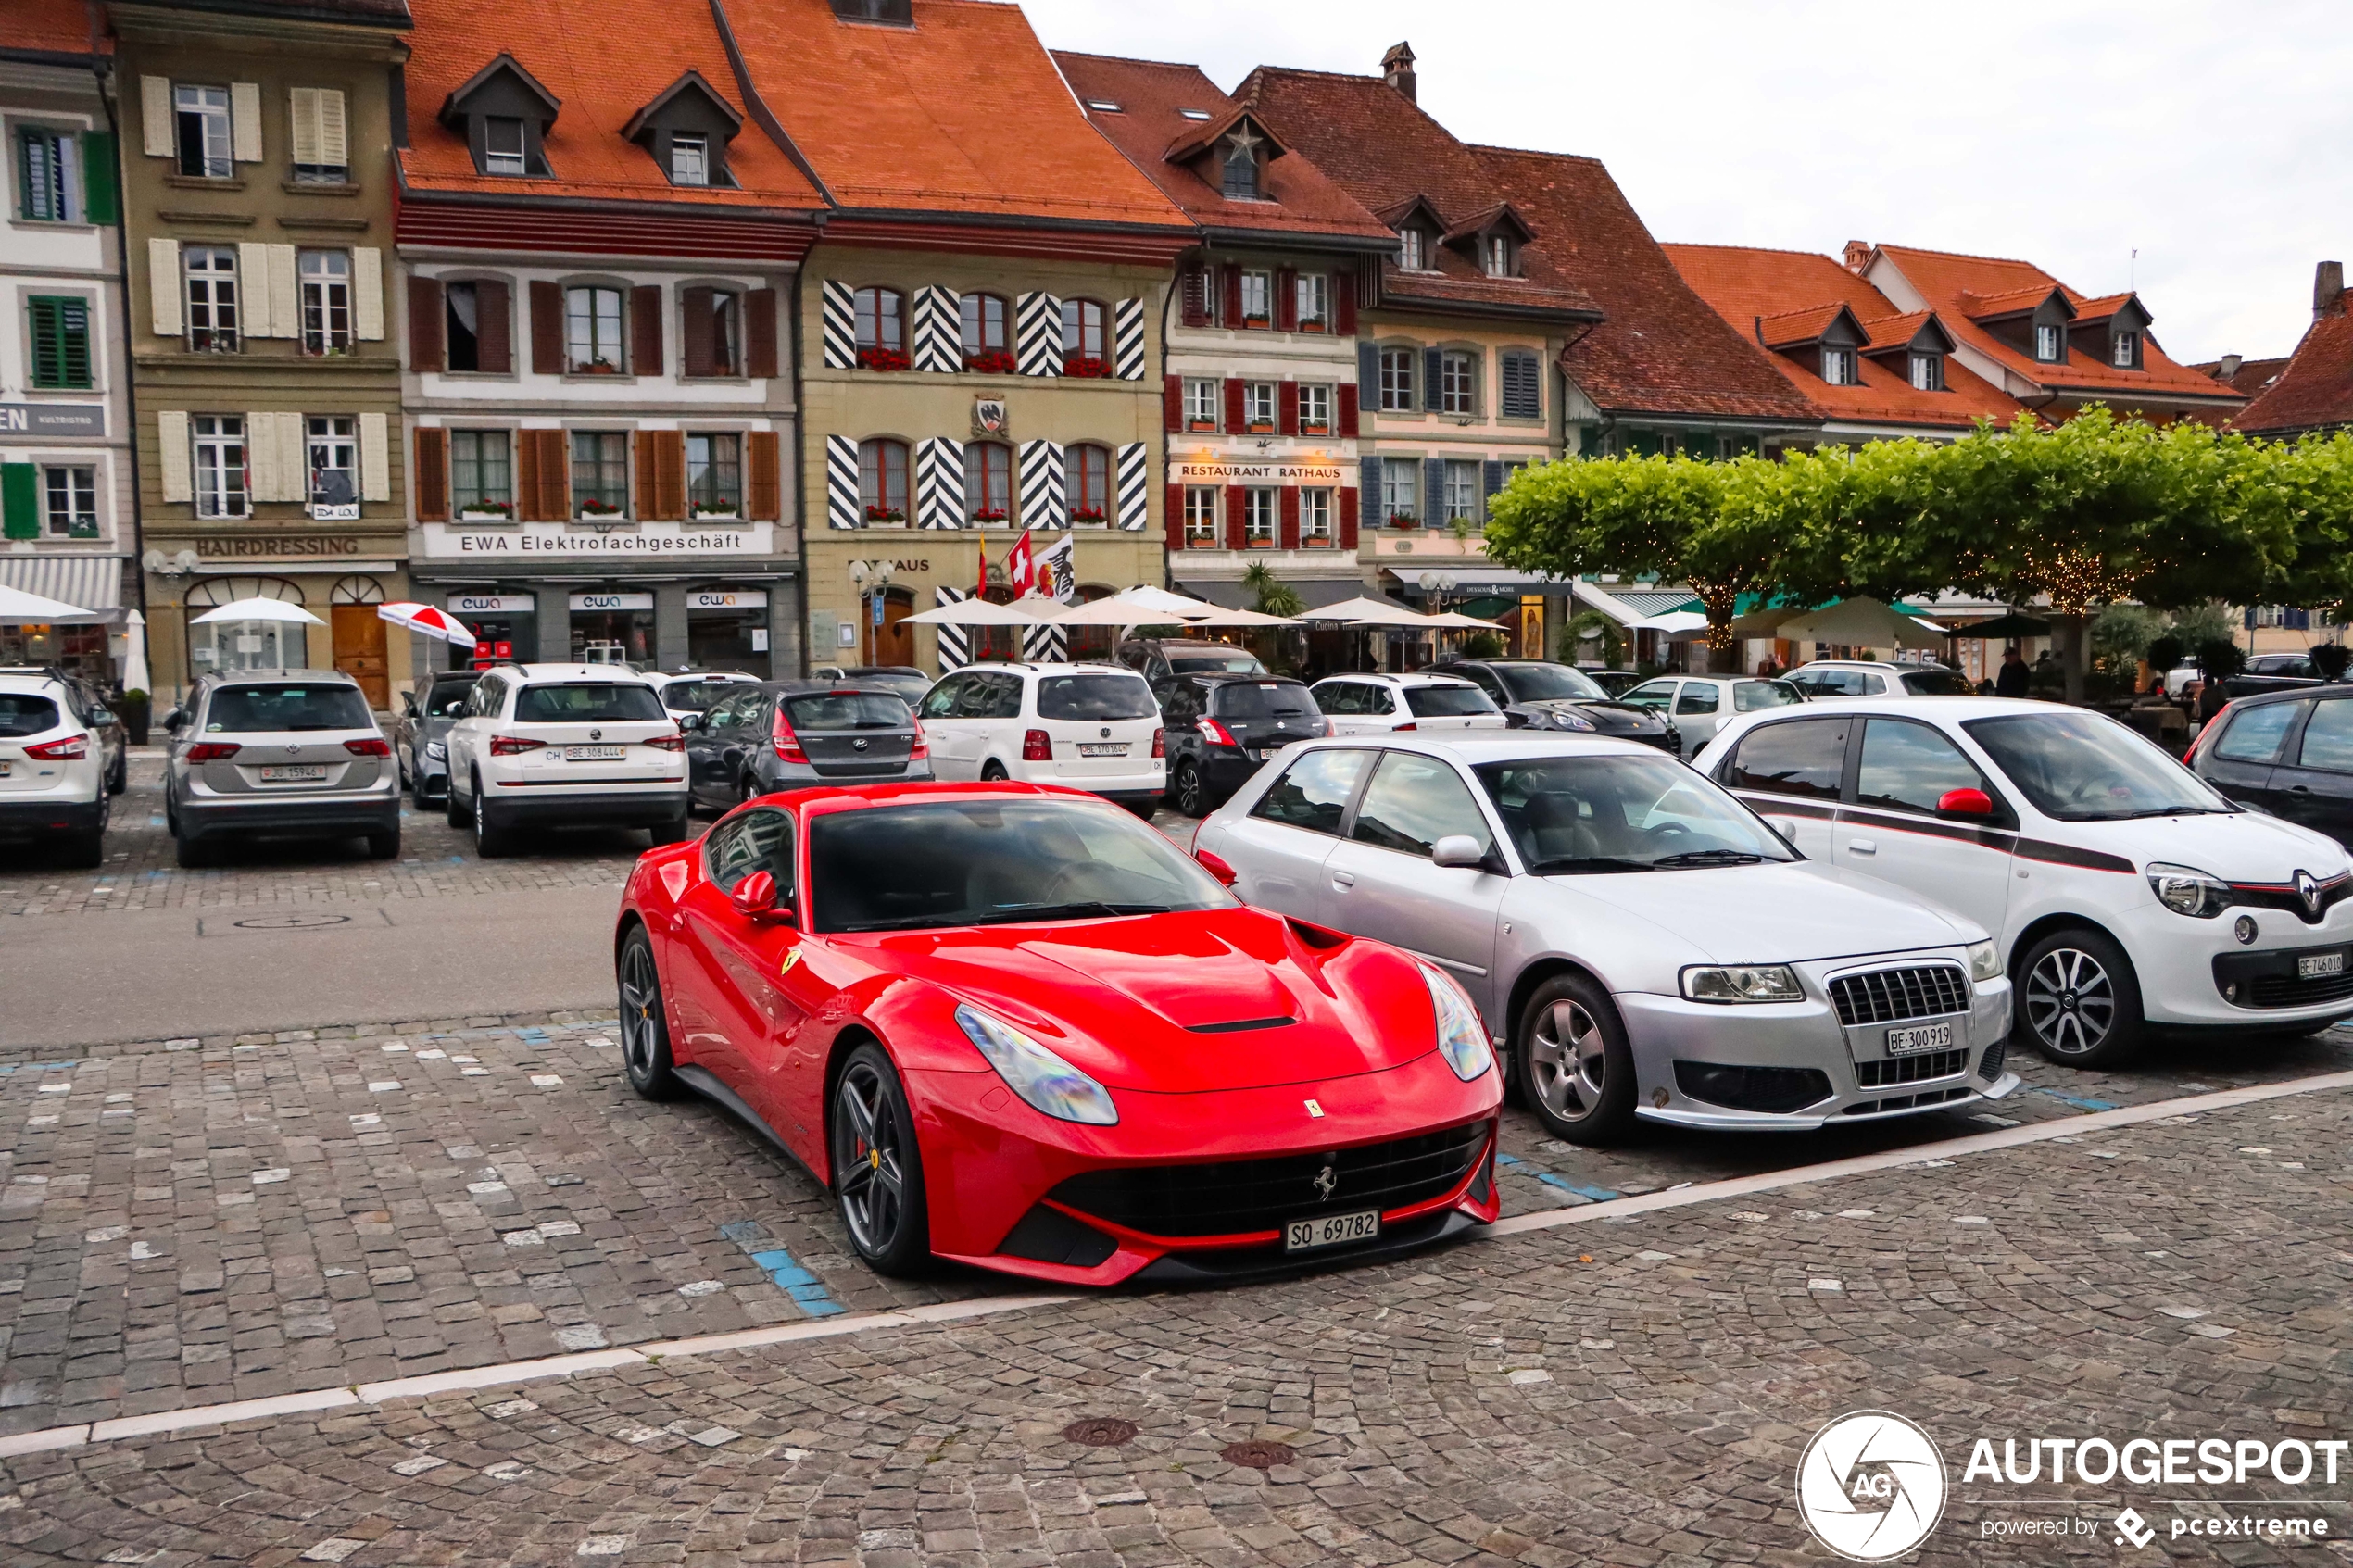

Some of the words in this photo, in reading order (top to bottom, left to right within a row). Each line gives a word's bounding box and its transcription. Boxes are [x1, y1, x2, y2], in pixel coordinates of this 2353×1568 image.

[1182, 466, 1270, 477] RESTAURANT
[1279, 468, 1340, 478] RATHAUS
[317, 508, 333, 517] IDA
[196, 538, 359, 556] HAIRDRESSING
[461, 536, 509, 551] EWA
[522, 534, 741, 552] Elektrofachgeschäft
[1491, 584, 1499, 595] &
[461, 597, 501, 609] ewa
[583, 596, 621, 608] ewa
[699, 595, 736, 606] ewa
[1315, 621, 1339, 631] Cucina
[546, 751, 560, 761] CH
[1153, 761, 1162, 771] CH
